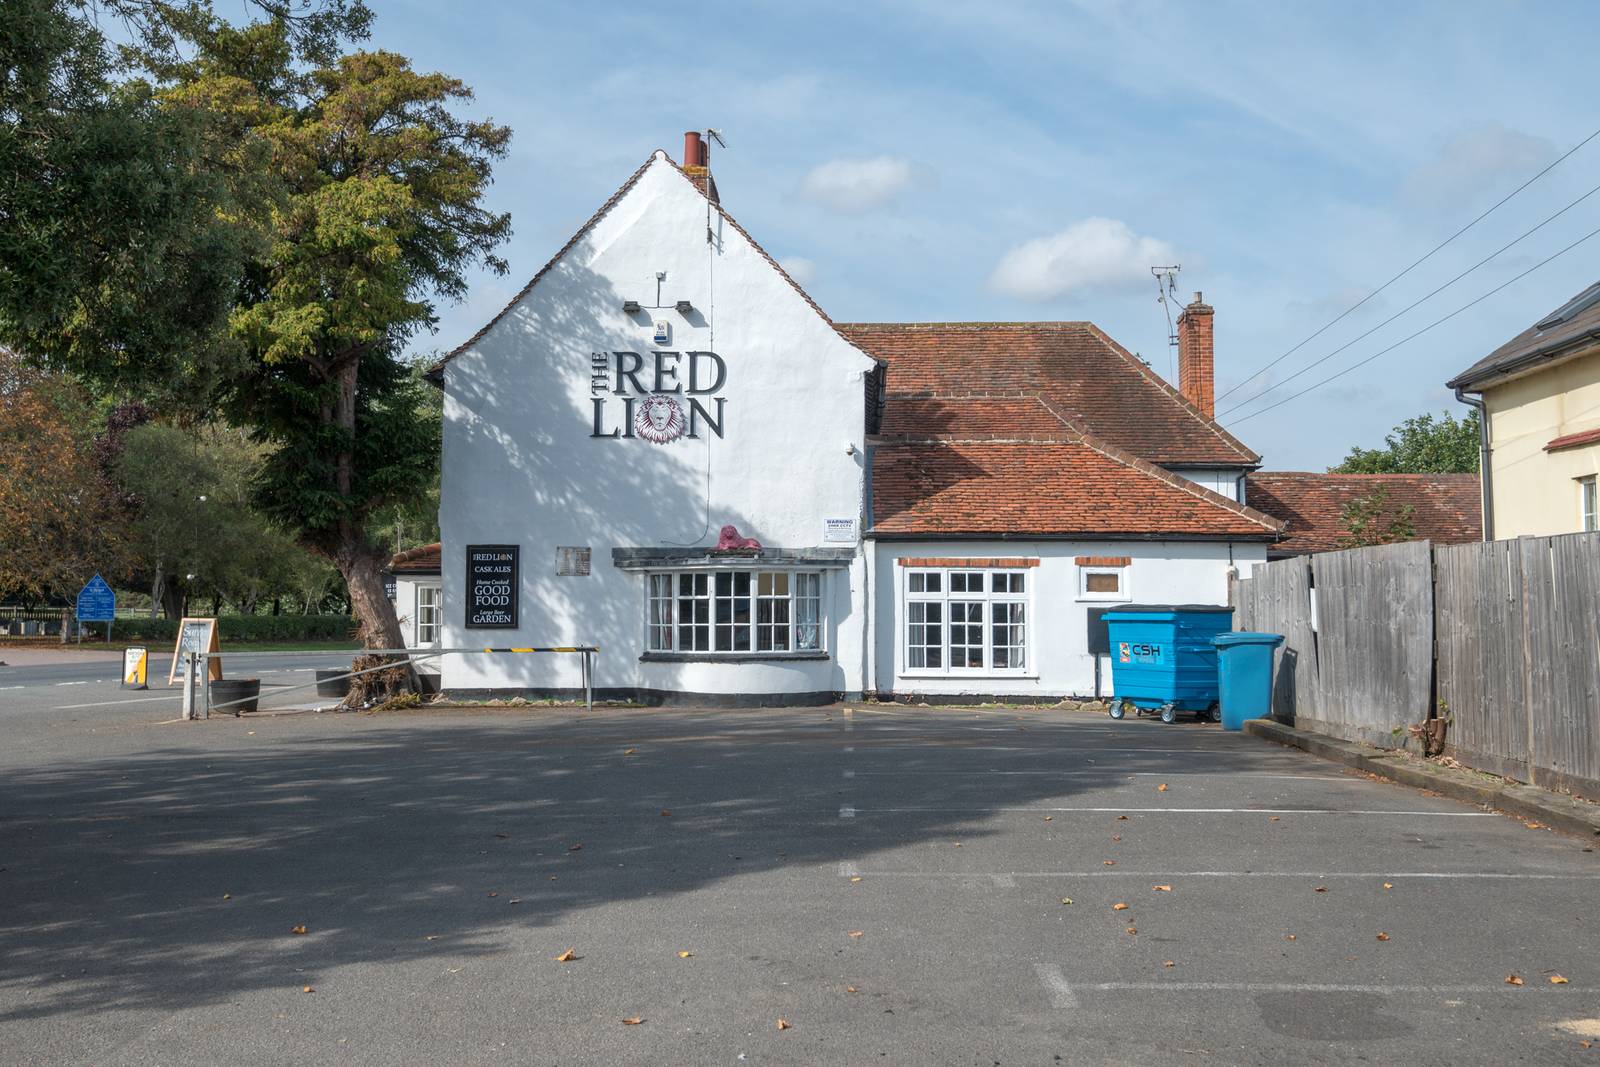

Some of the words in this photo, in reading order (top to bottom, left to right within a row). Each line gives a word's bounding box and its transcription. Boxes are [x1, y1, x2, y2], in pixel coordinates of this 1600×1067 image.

[592, 352, 609, 396] THE
[612, 351, 727, 395] RED
[474, 586, 510, 596] GOOD
[476, 596, 510, 606] FOOD
[473, 614, 512, 624] GARDEN
[1132, 644, 1160, 656] CSH
